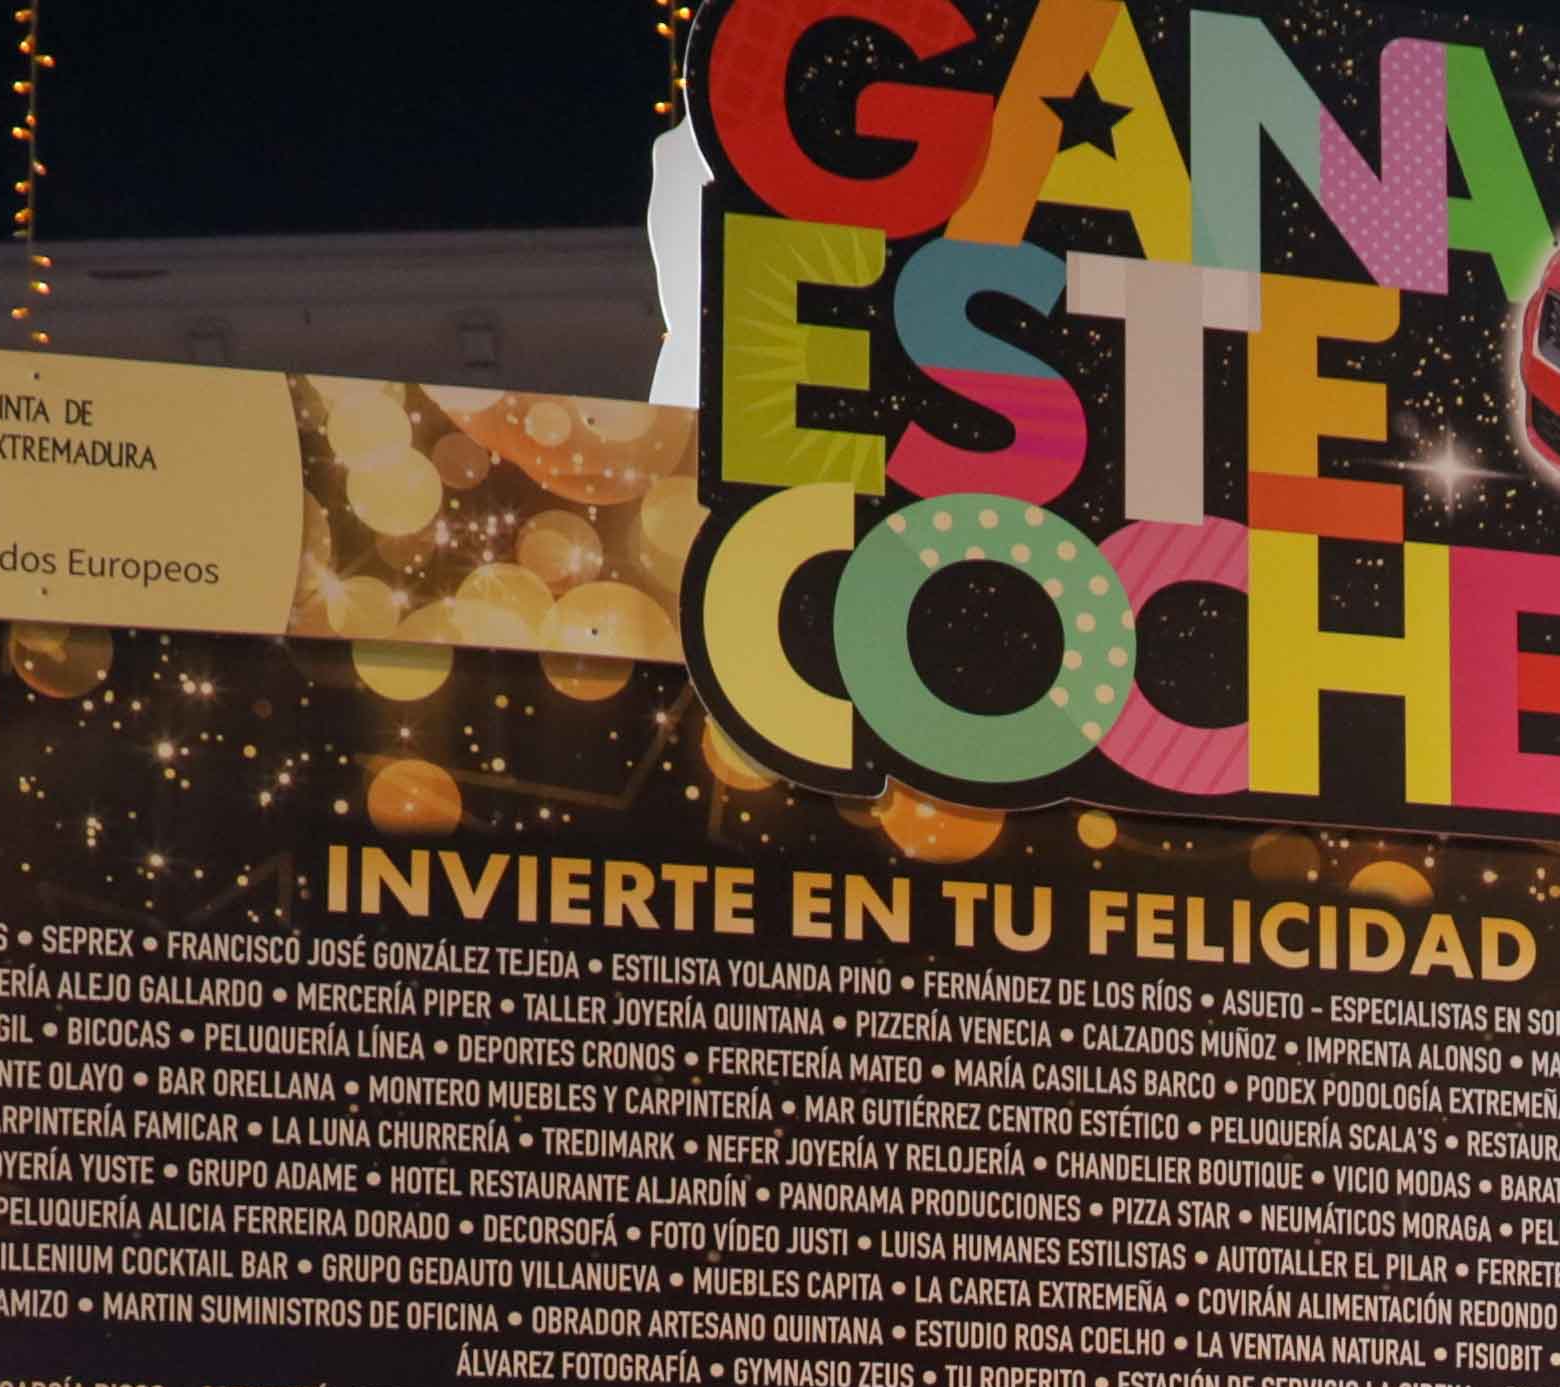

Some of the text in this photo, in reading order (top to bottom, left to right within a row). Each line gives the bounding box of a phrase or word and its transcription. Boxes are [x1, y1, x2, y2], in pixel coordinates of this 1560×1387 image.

[707, 0, 1557, 303] GANA
[64, 398, 93, 427] DE
[721, 214, 1404, 541] ESTE
[69, 546, 220, 586] Europeos
[328, 845, 754, 934] INVIERTE
[792, 872, 910, 943] EN
[942, 881, 1052, 952] TU
[1089, 886, 1536, 981] FELICIDAD
